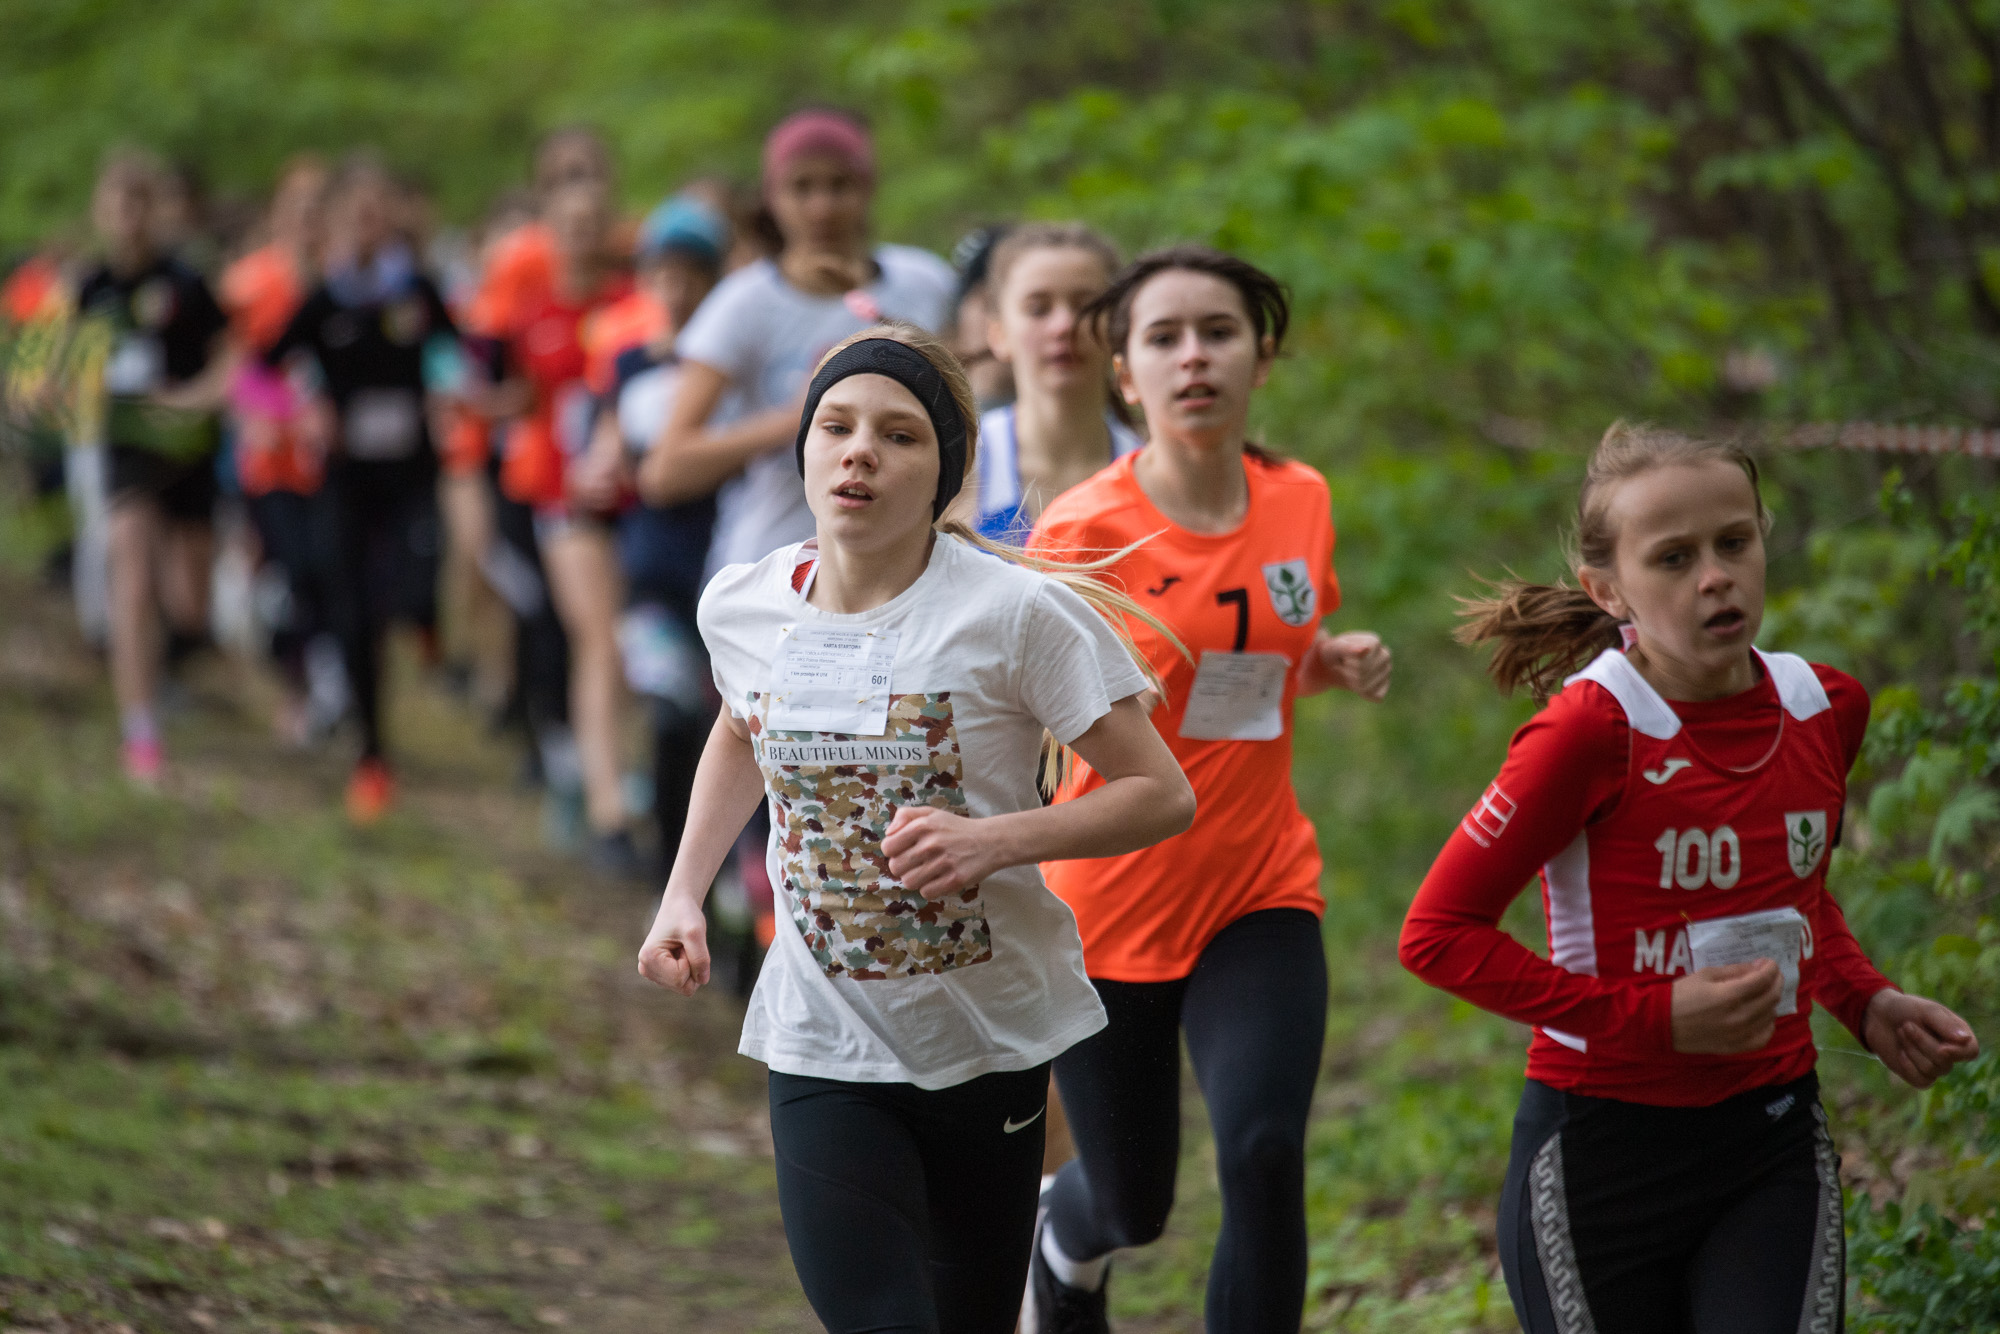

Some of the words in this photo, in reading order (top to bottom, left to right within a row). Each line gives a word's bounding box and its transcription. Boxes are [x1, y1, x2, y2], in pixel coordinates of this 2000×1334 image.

[871, 675, 887, 685] 601
[769, 746, 863, 761] BEAUTIFUL
[865, 746, 923, 761] MINDS
[1654, 825, 1741, 890] 100
